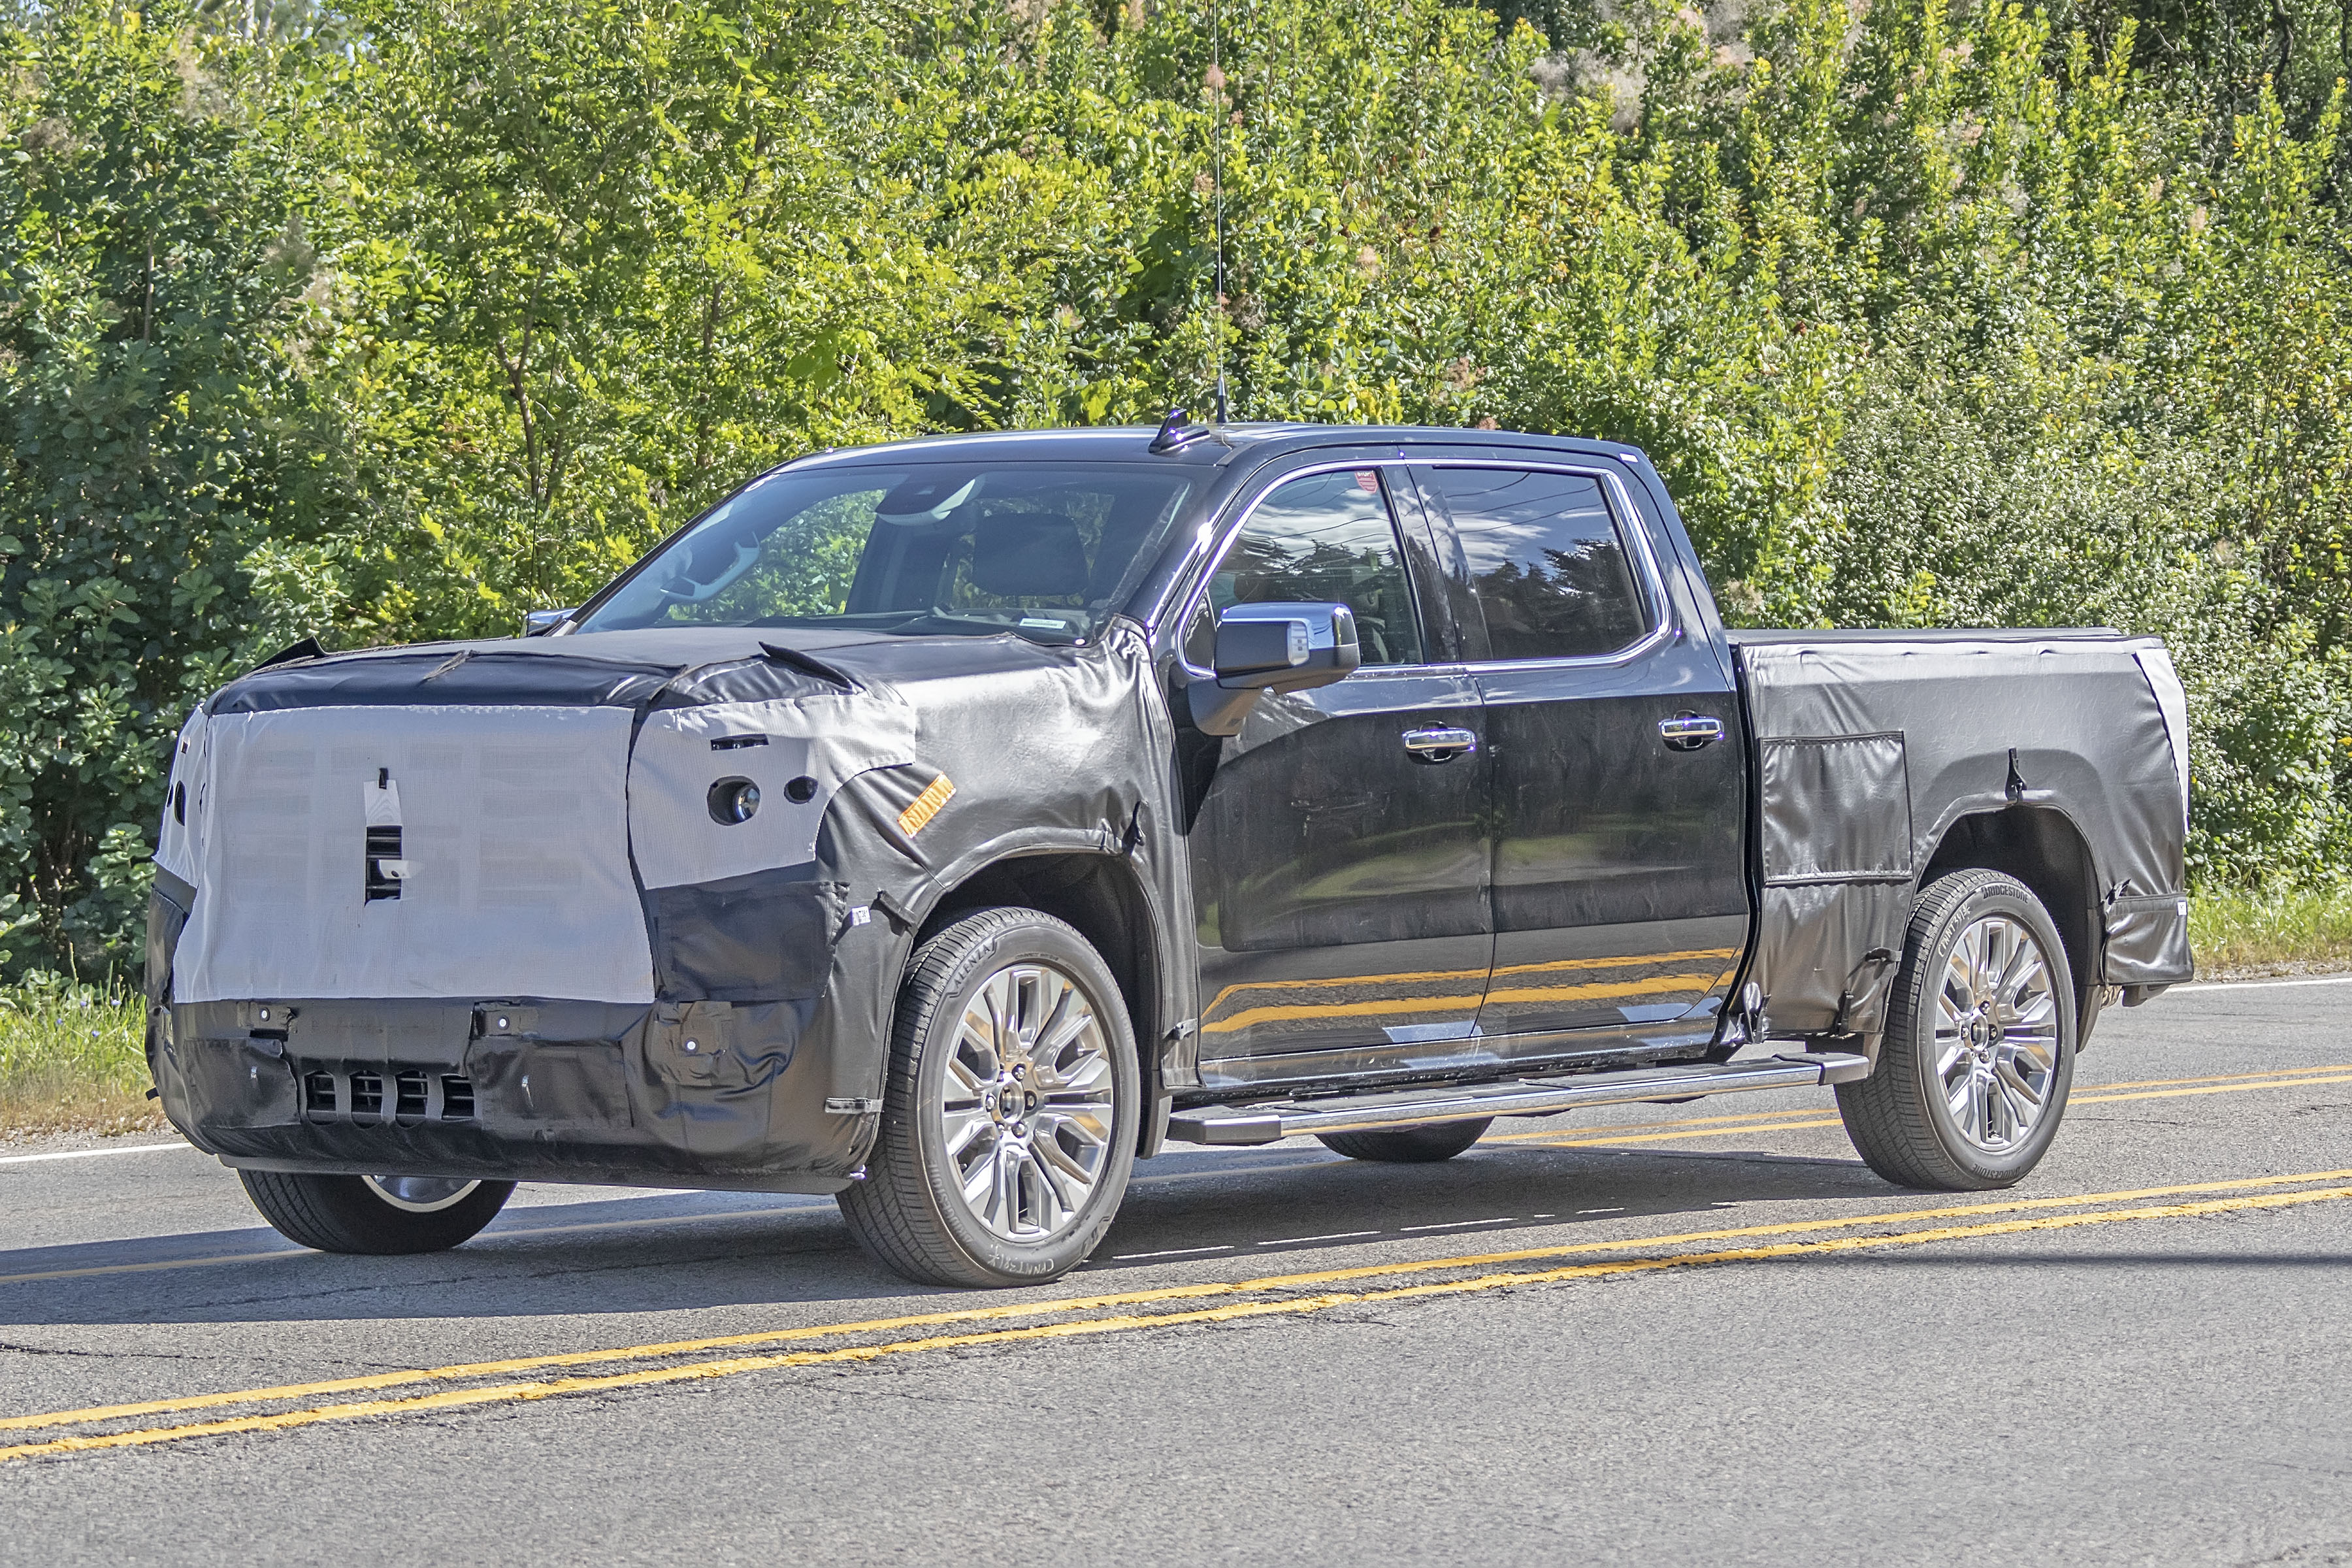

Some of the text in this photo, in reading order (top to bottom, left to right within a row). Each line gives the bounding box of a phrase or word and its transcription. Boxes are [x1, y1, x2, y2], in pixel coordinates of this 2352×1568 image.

[1981, 885, 2029, 904] BRIDGESTONE
[954, 943, 990, 989] ALENZA
[928, 1160, 973, 1242] BRIDGESTONE
